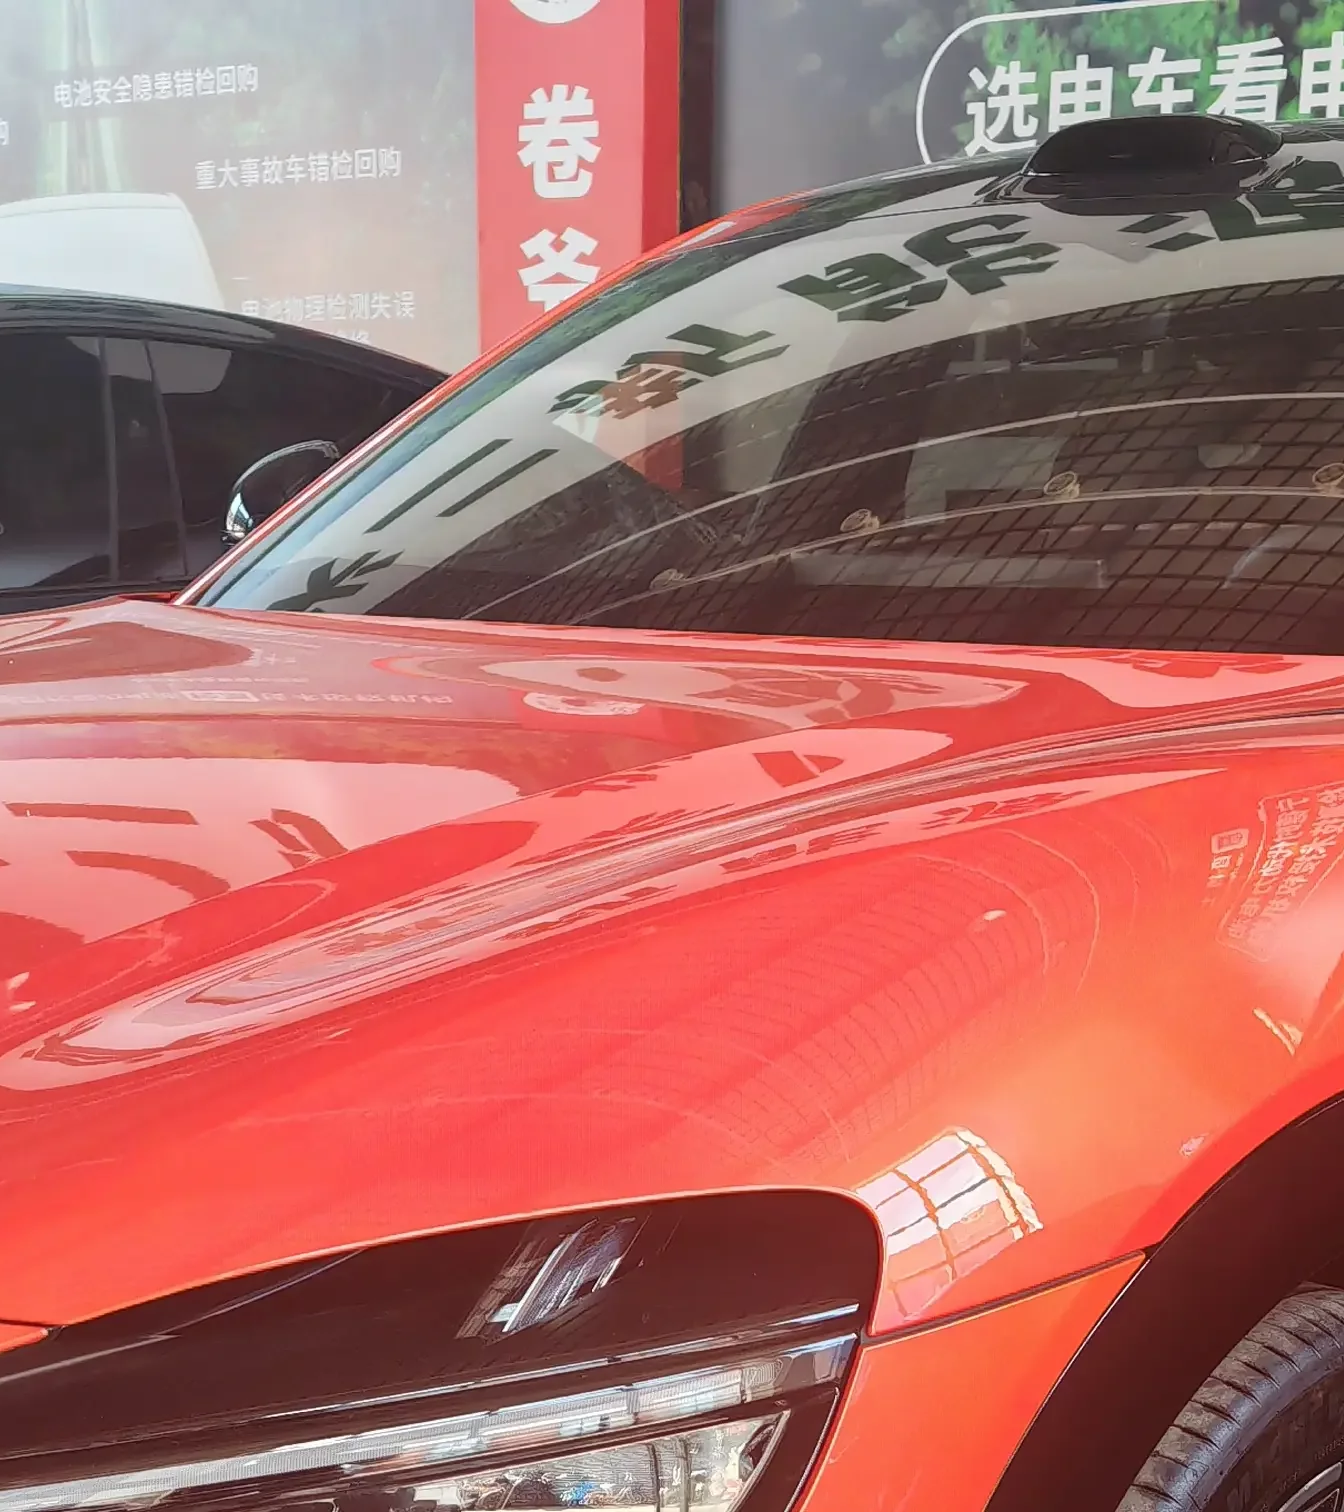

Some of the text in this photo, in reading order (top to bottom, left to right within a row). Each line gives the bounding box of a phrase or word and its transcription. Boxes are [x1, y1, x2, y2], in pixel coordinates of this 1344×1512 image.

[53, 63, 259, 109] 电池安全隐患错检回购
[194, 146, 402, 191] 重大事故车错检回购
